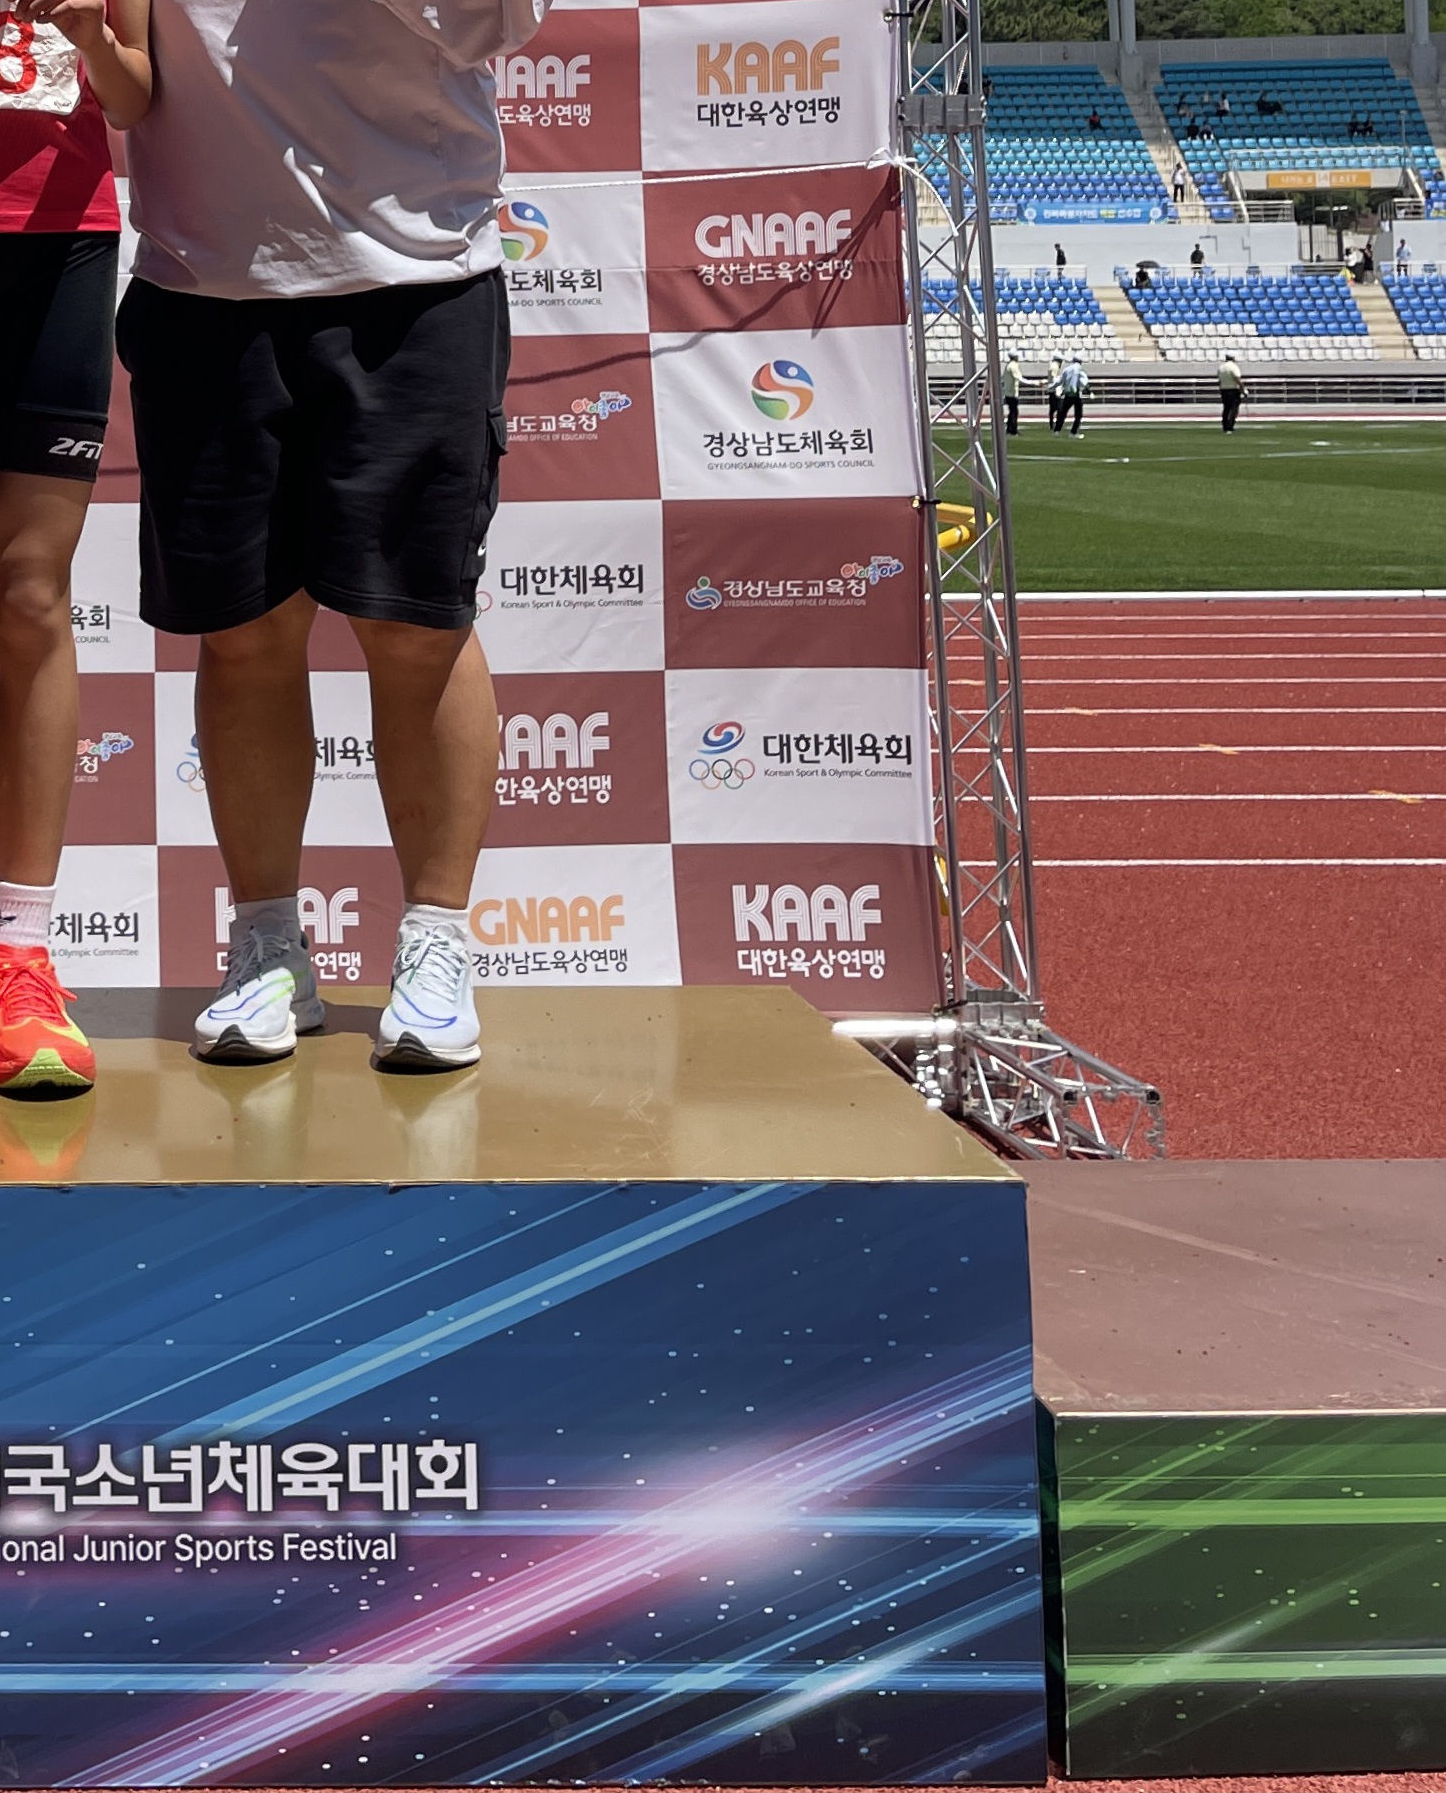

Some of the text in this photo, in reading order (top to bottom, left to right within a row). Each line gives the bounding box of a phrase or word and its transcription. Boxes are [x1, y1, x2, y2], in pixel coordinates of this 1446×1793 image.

[490, 54, 590, 98] NAAF
[697, 37, 840, 96] KAAF
[499, 104, 591, 127] 도육상연맹
[698, 97, 840, 127] 대한육상연맹
[695, 209, 852, 259] GNAAF
[509, 269, 602, 293] 도체육회
[697, 259, 854, 286] 경상남도육상연맹
[567, 298, 602, 306] COUNCIL
[507, 414, 598, 432] 남도교육청
[704, 428, 873, 457] 경상남도체육회
[707, 462, 802, 470] GYEONGSANGNAM-DO
[501, 564, 643, 595] 대한체육회
[724, 579, 866, 597] 경상남도교육청
[532, 600, 554, 609] Sport
[563, 600, 595, 609] Olympic
[598, 599, 643, 607] Committee
[828, 597, 866, 606] EDUCATION
[74, 636, 110, 644] COUNCIL
[498, 712, 610, 770] AAF
[763, 734, 911, 765] 대한체육회
[346, 771, 376, 779] Commi
[796, 769, 818, 777] Sport
[829, 769, 863, 778] Olympic
[865, 769, 912, 778] Committee
[495, 775, 611, 805] 한육상연맹
[48, 912, 139, 943] 체육회
[215, 887, 360, 944] KAF
[469, 895, 625, 945] GNAAF
[732, 885, 881, 941] KAAF
[58, 949, 91, 958] Olympic
[93, 948, 139, 956] Committee
[472, 949, 627, 977] 경상남도육상연맹
[738, 948, 885, 979] 대한육상연맹
[74, 1534, 166, 1562] Junior
[175, 1534, 273, 1570] Sports
[282, 1533, 397, 1563] Festival
